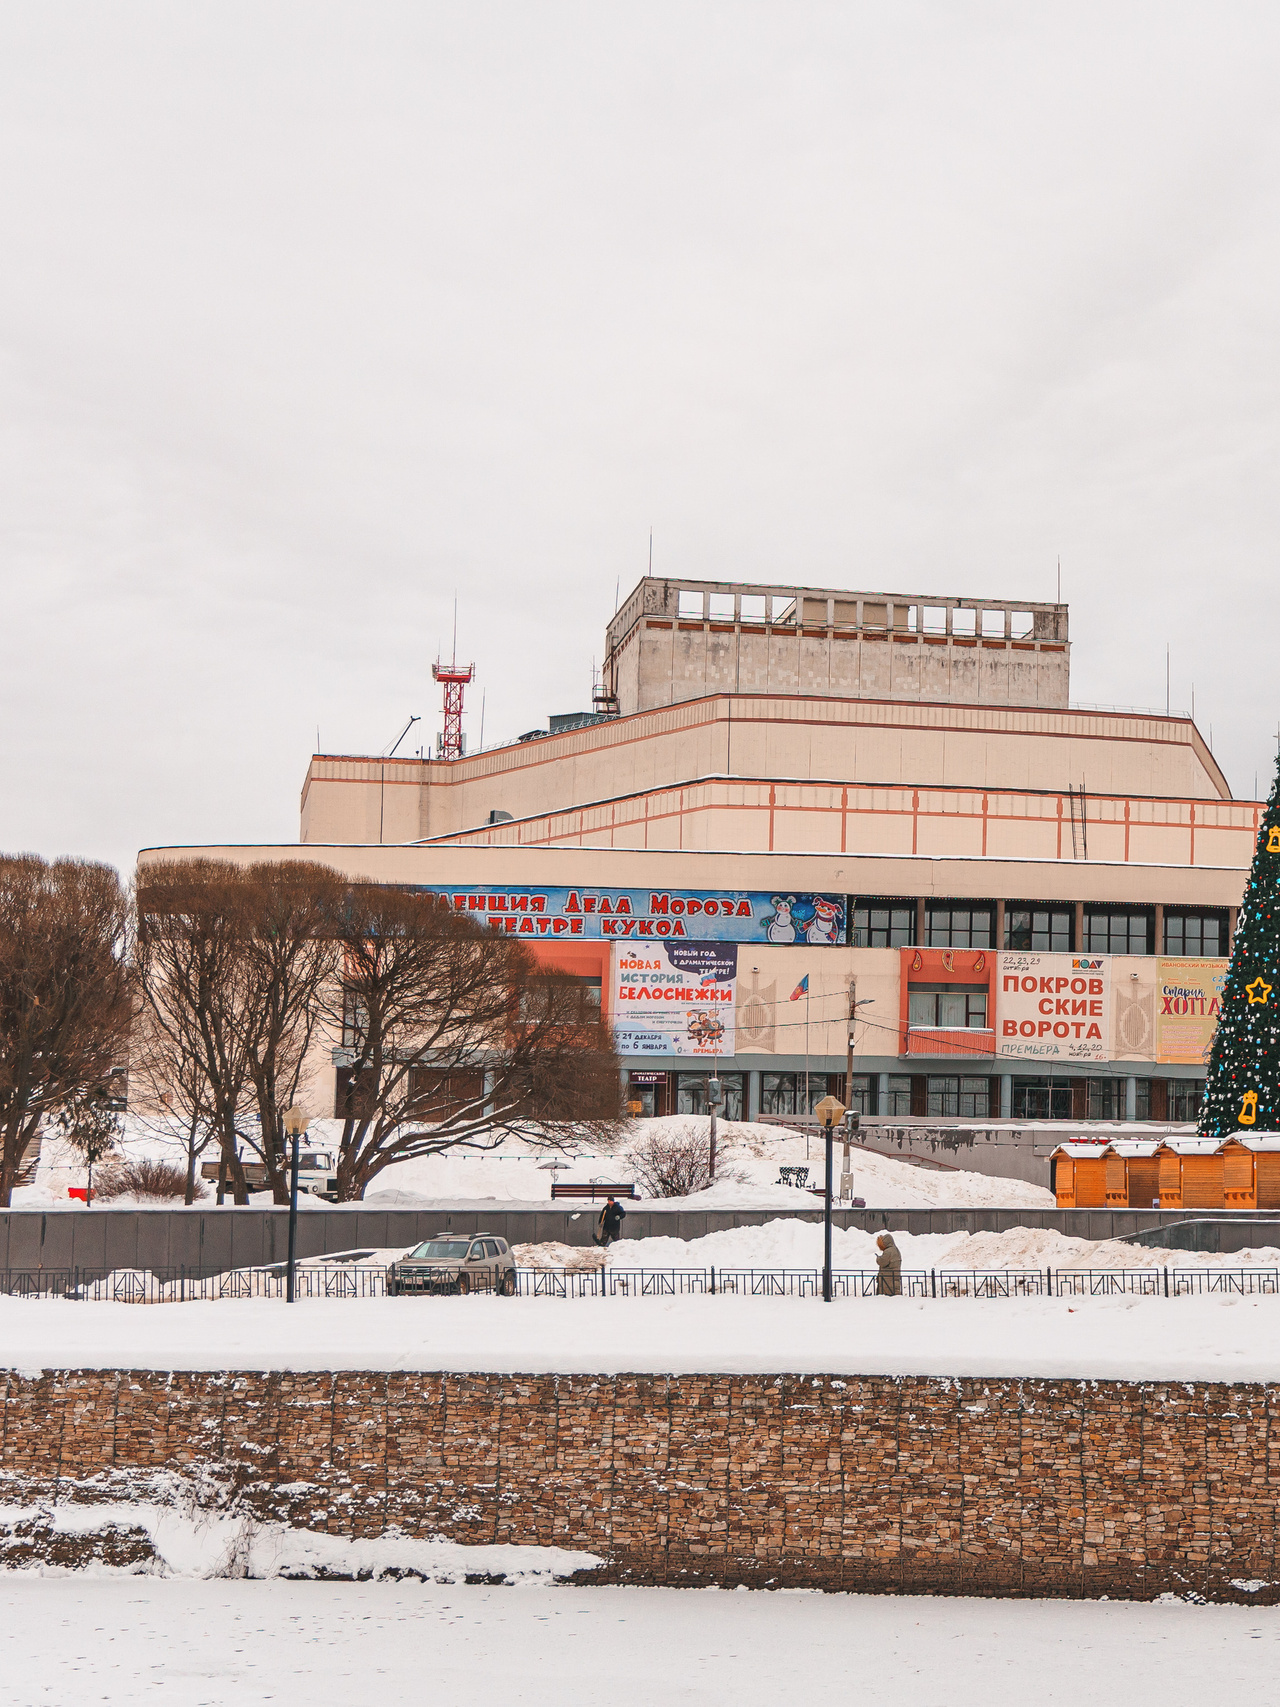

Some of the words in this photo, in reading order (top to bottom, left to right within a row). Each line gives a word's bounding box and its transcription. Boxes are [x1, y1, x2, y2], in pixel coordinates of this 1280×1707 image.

[564, 891, 633, 915] ДЕДА
[650, 893, 753, 917] МОРОЗА
[487, 915, 585, 935] ТЕАТРЕ
[601, 918, 687, 937] КУКОЛ
[620, 959, 661, 970] НОВАЯ
[1003, 956, 1016, 965] 22,
[621, 973, 683, 984] ИСТОРИЯ
[1003, 975, 1104, 995] ПОКРОВ
[619, 986, 732, 1001] БЕЛОСНЕЖКИ
[1163, 985, 1205, 1001] Старик
[1038, 998, 1103, 1017] СКИЕ
[1160, 996, 1222, 1016] ХОТТА
[1002, 1020, 1103, 1040] ВОРОТА
[633, 1041, 639, 1050] 6
[1001, 1044, 1060, 1055] ПРЕМЬЕРА
